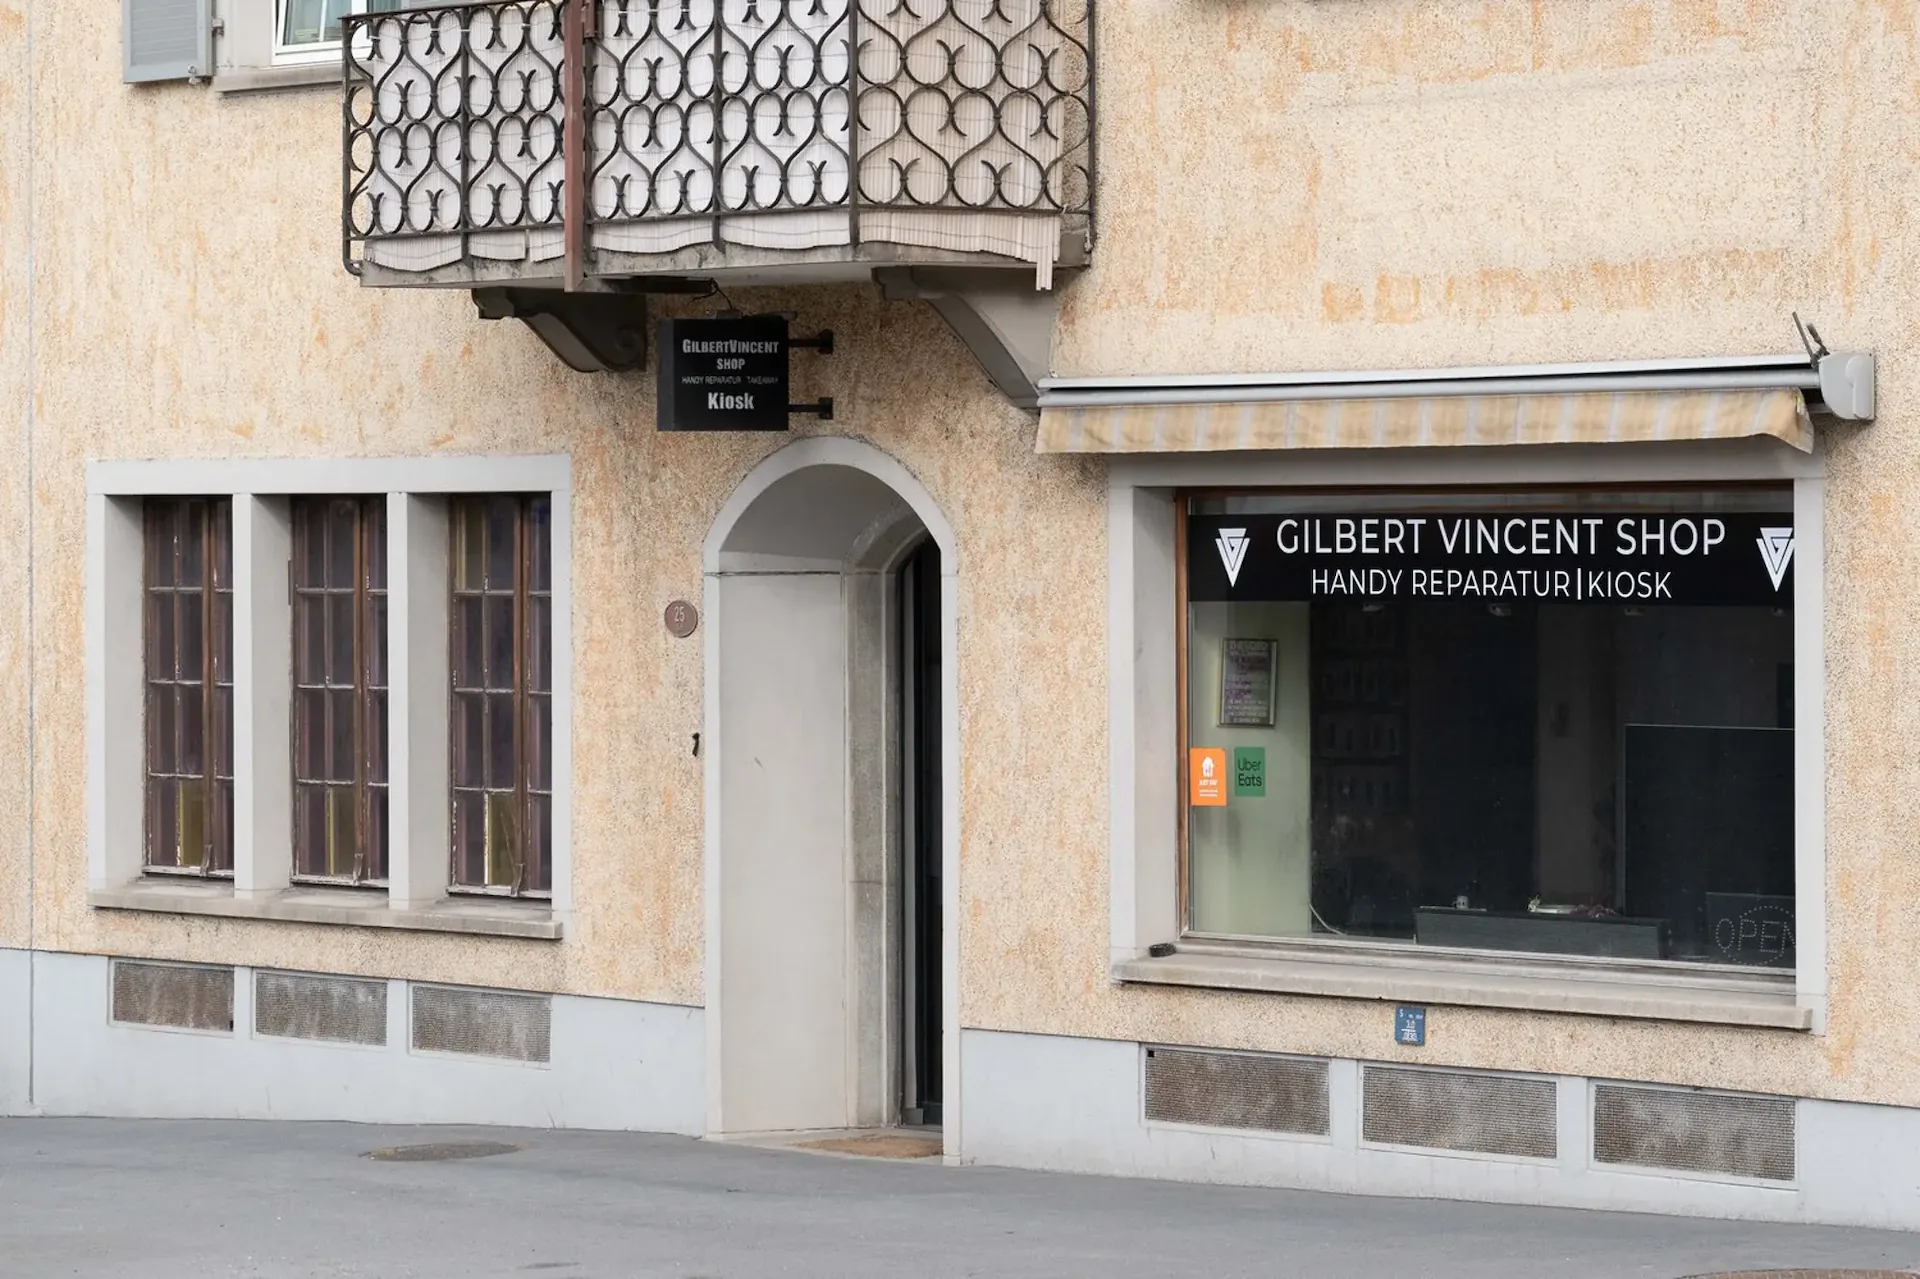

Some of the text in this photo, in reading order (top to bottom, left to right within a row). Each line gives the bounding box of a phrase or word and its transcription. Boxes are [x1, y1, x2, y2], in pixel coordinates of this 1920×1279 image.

[716, 357, 746, 370] SHOP
[681, 375, 704, 385] HANDY
[705, 375, 742, 385] REPARATUR
[707, 391, 755, 410] Kiosk
[1276, 518, 1726, 556] GILBERT VINCENT SHOP
[1311, 568, 1403, 595] HANDY
[1237, 758, 1262, 772] Uber
[1237, 773, 1262, 787] Eats
